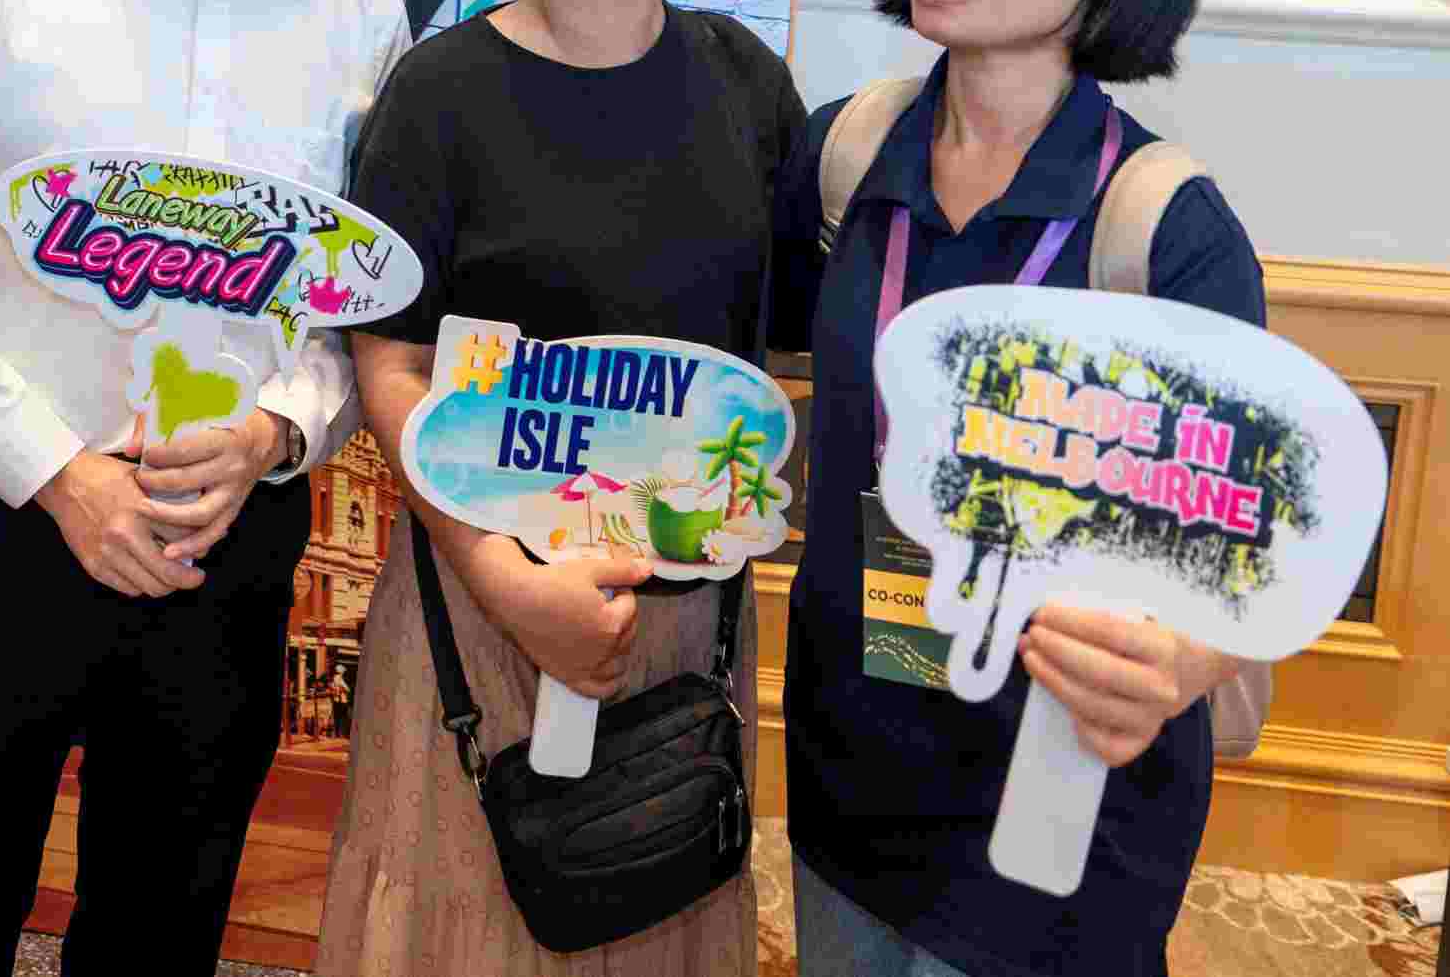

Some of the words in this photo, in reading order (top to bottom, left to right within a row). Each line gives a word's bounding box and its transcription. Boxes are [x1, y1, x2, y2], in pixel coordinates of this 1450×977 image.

[94, 173, 262, 251] Laneway
[34, 197, 298, 316] Legend
[498, 406, 595, 475] ISLE
[1015, 365, 1163, 453] MADE
[955, 402, 1264, 536] MELBOURNE
